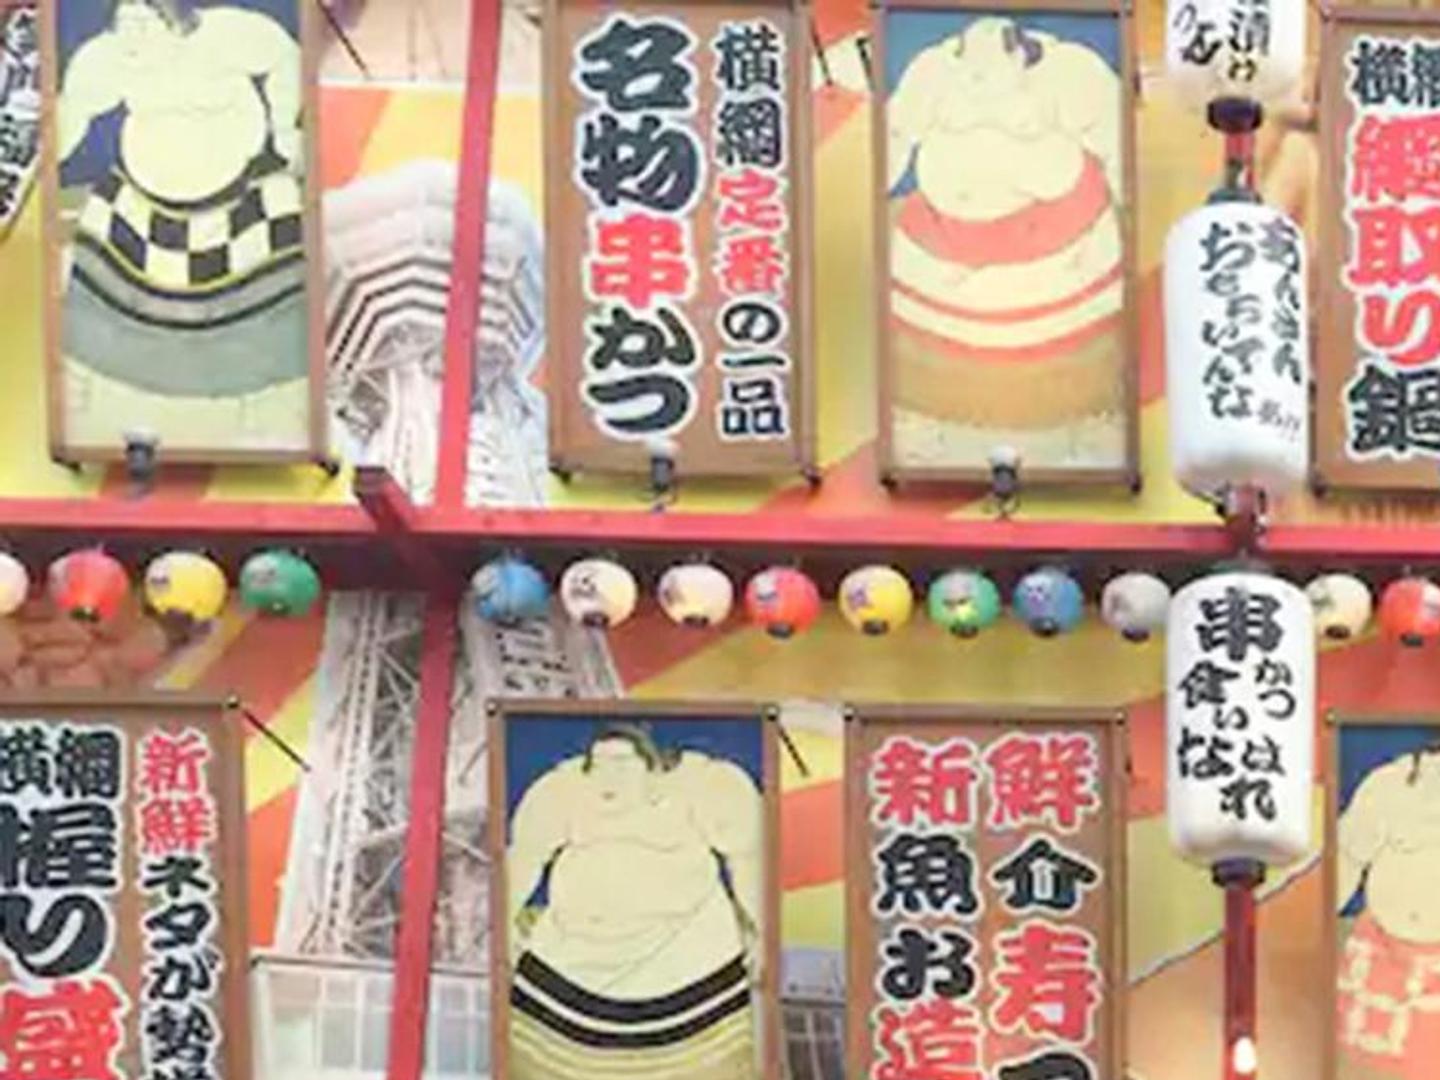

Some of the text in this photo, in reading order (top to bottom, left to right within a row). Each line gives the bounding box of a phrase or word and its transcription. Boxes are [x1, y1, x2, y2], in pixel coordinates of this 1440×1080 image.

[580, 21, 699, 434] 名物串かつ
[715, 24, 784, 436] 横綱定番の一品
